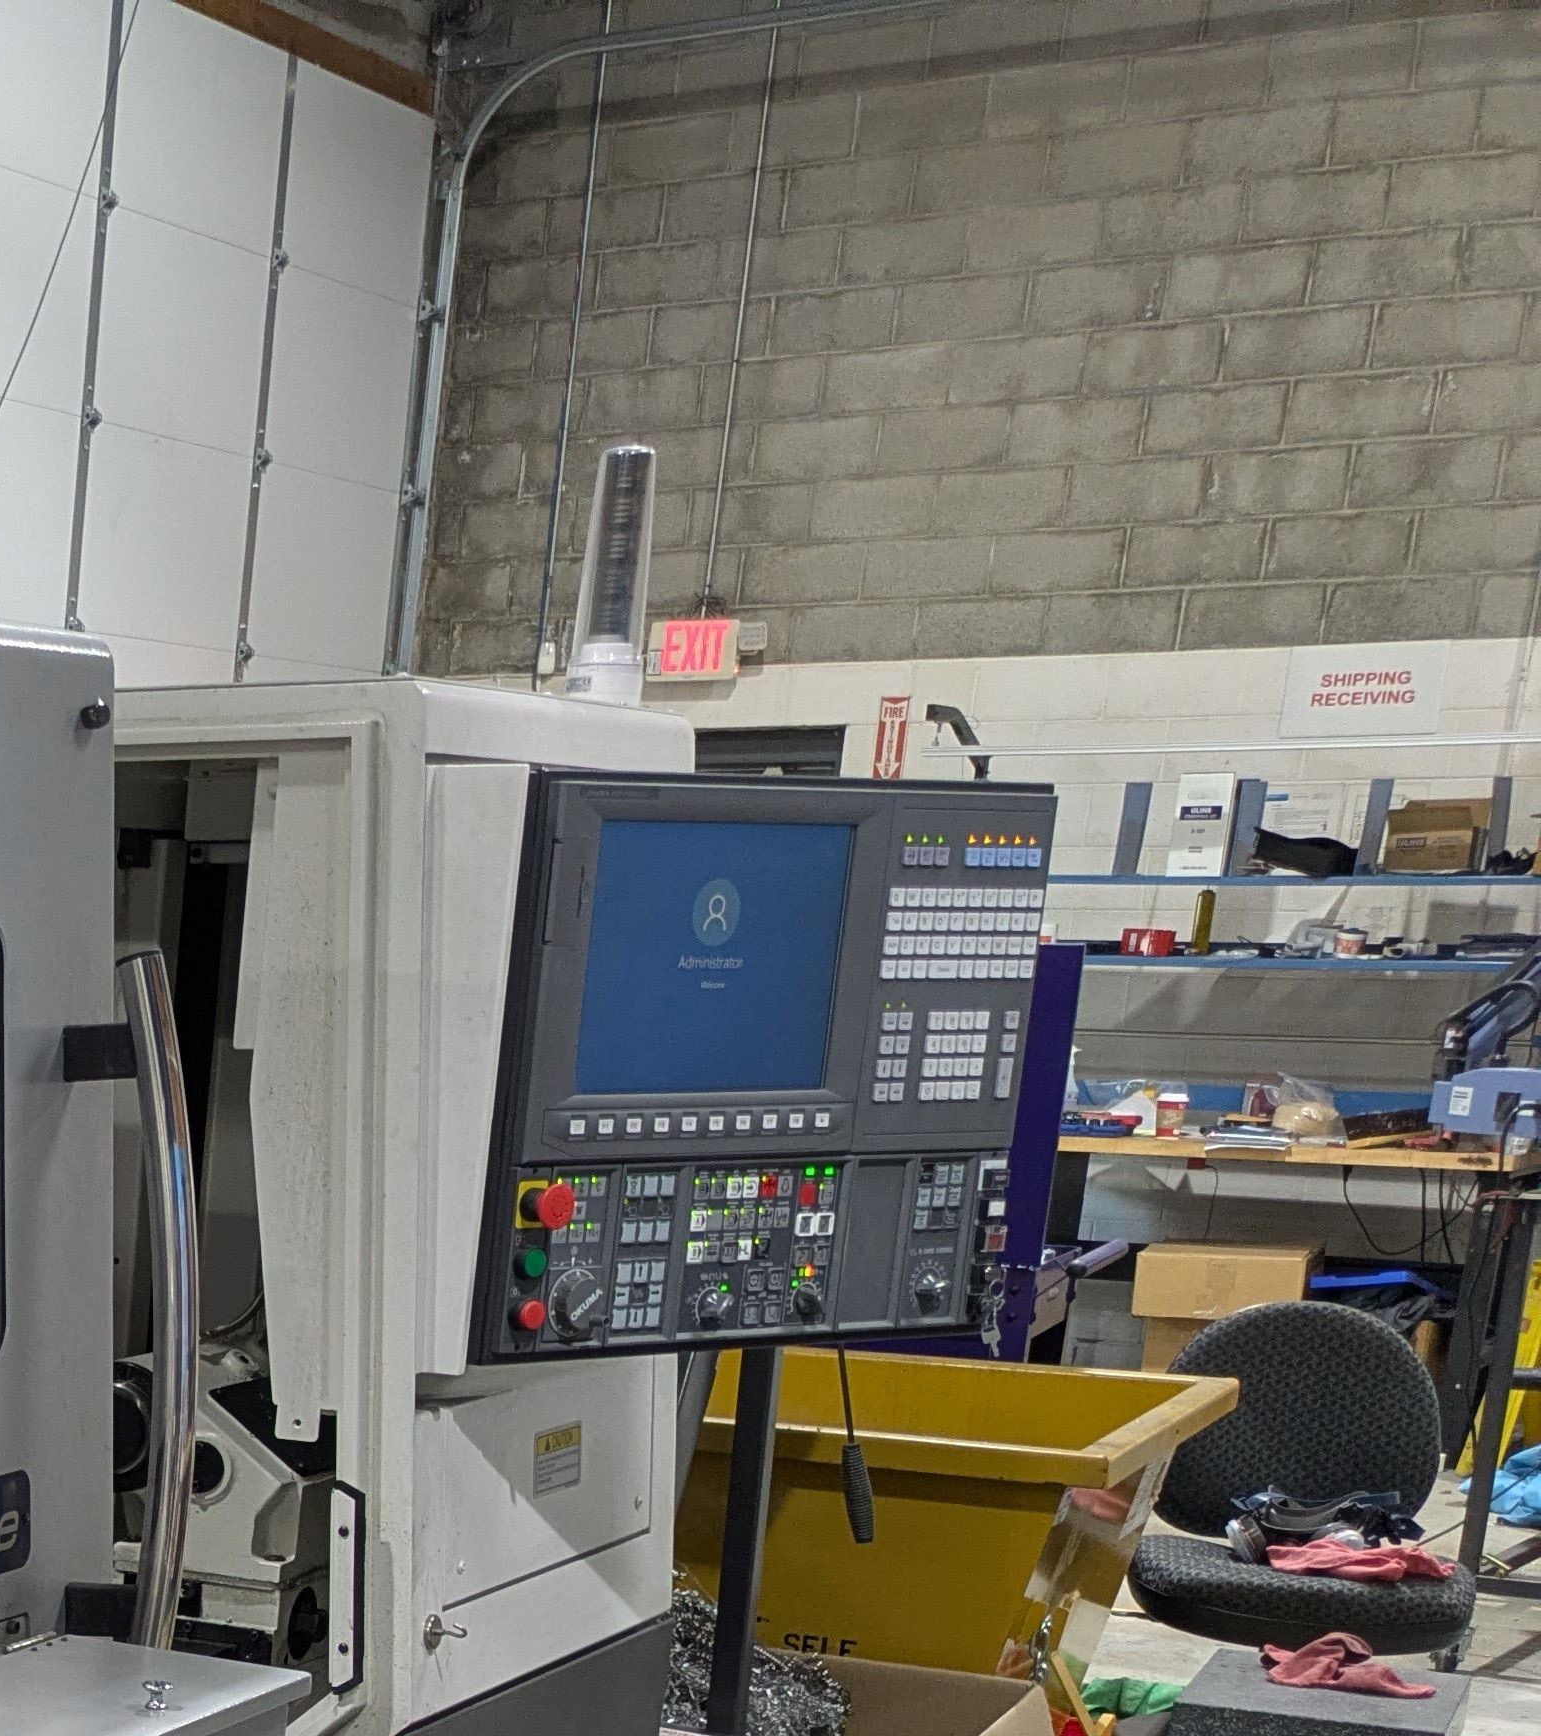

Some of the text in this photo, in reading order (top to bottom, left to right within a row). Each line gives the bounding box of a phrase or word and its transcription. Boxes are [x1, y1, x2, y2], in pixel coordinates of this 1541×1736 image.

[661, 623, 729, 672] EXIT
[1321, 671, 1412, 688] SHIPPING
[1311, 690, 1415, 707] RECEIVING
[884, 706, 905, 718] FIRE
[678, 955, 743, 969] Administrator
[570, 1288, 604, 1321] OKUMA
